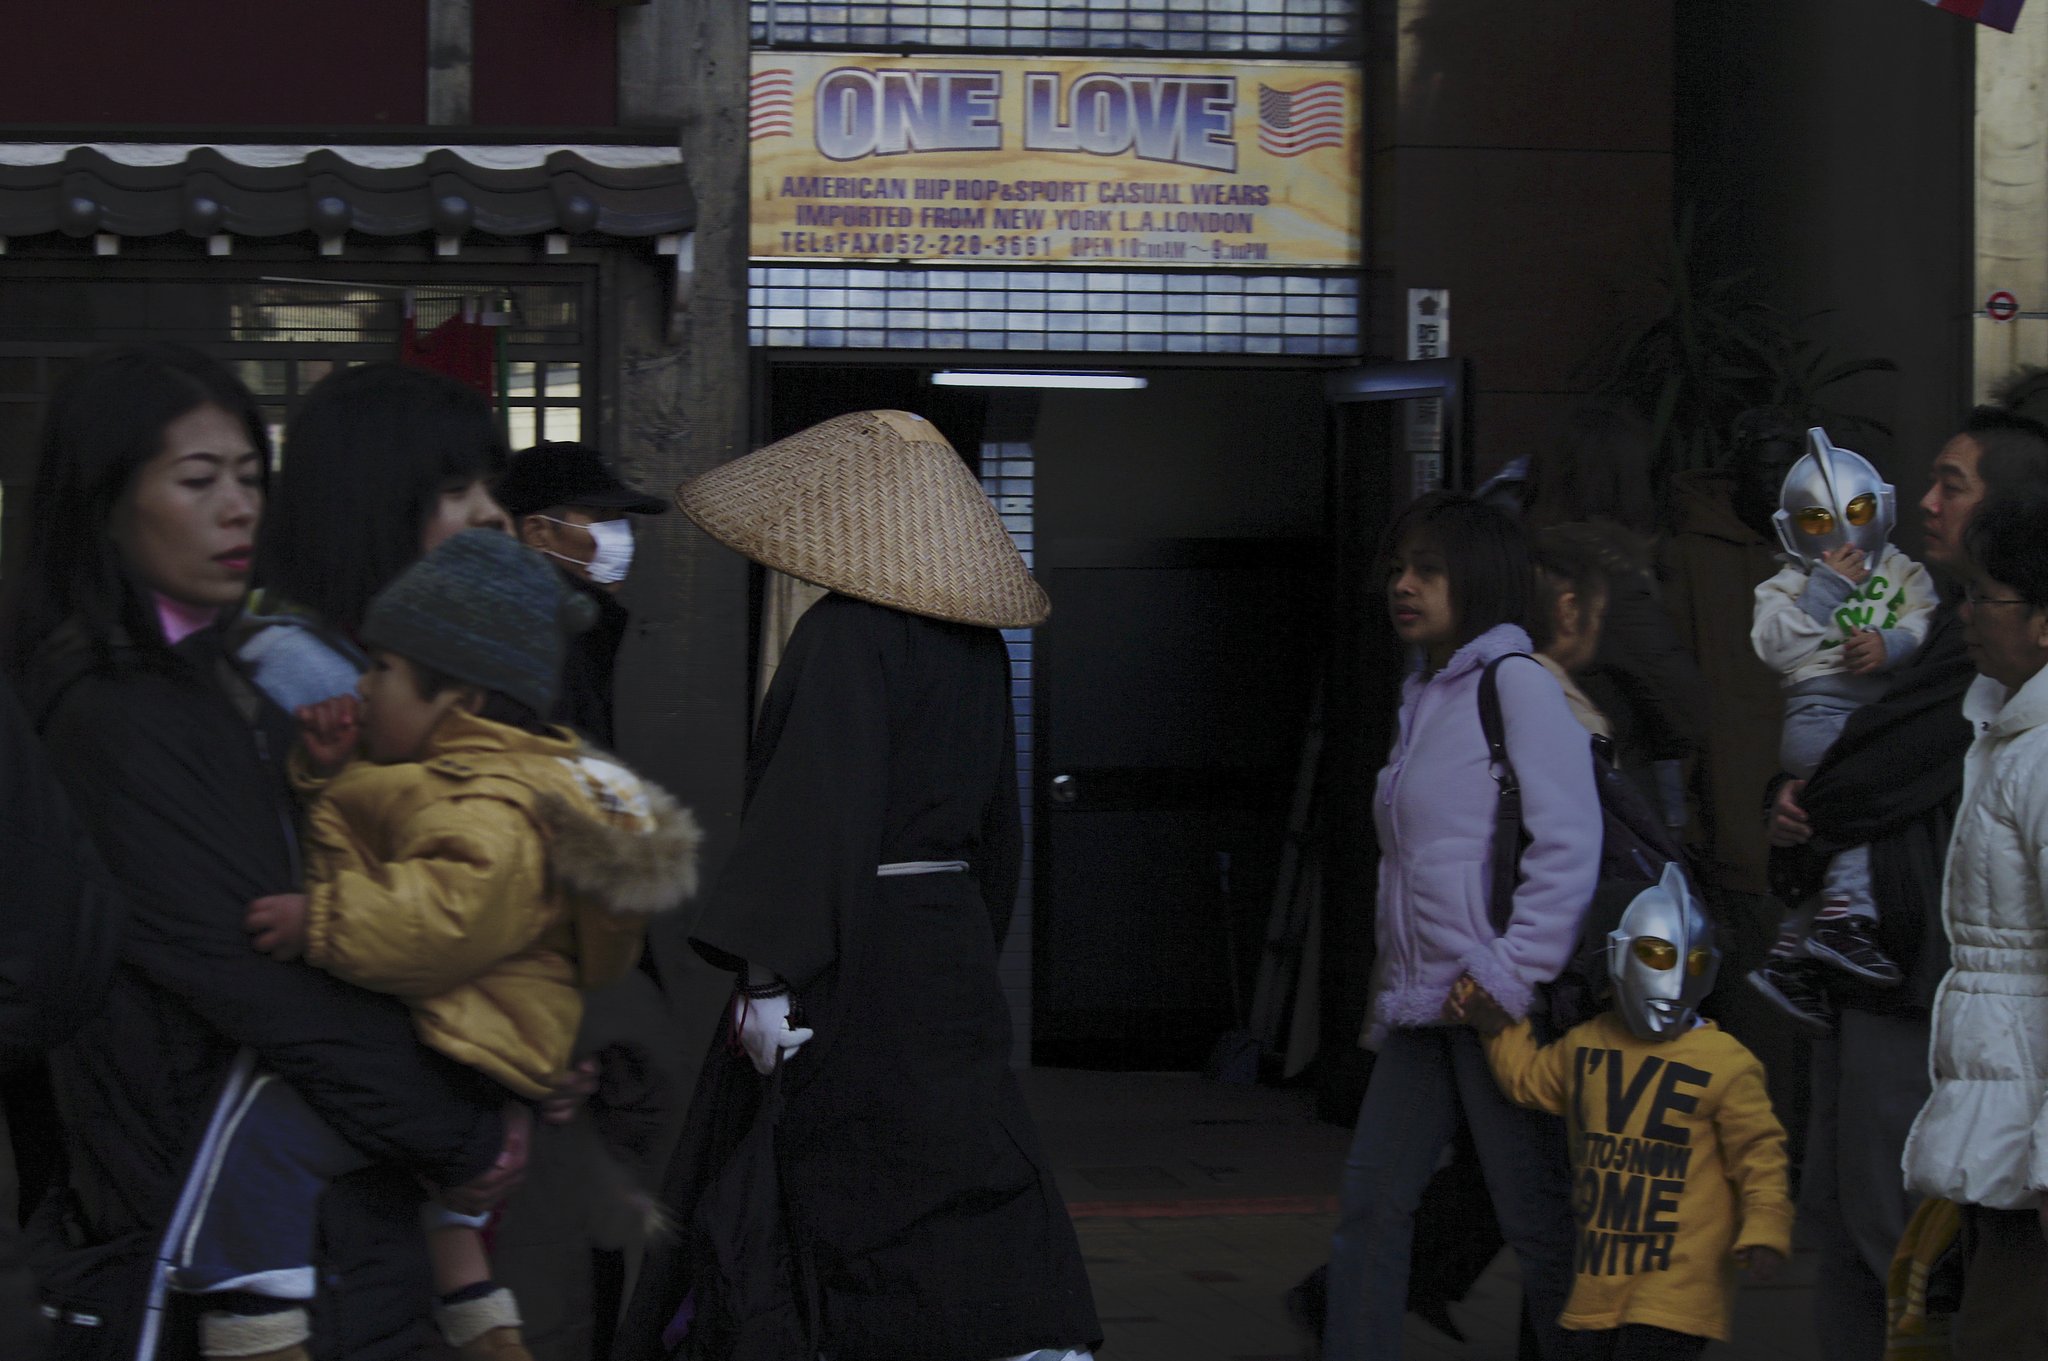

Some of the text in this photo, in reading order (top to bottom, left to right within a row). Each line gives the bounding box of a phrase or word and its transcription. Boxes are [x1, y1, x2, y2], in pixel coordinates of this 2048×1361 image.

[814, 66, 1237, 173] ONE LOVE
[781, 176, 905, 199] AMERICAN
[1099, 182, 1181, 204] CASUAL
[1192, 184, 1268, 206] WEARS
[797, 205, 911, 227] IMPORTED
[920, 207, 985, 229] FROM
[993, 208, 1045, 230] NEW
[1055, 209, 1111, 231] YORK
[1071, 237, 1112, 257] OPEN
[1574, 1047, 1713, 1146] I'VE
[1577, 1230, 1675, 1276] WITH
